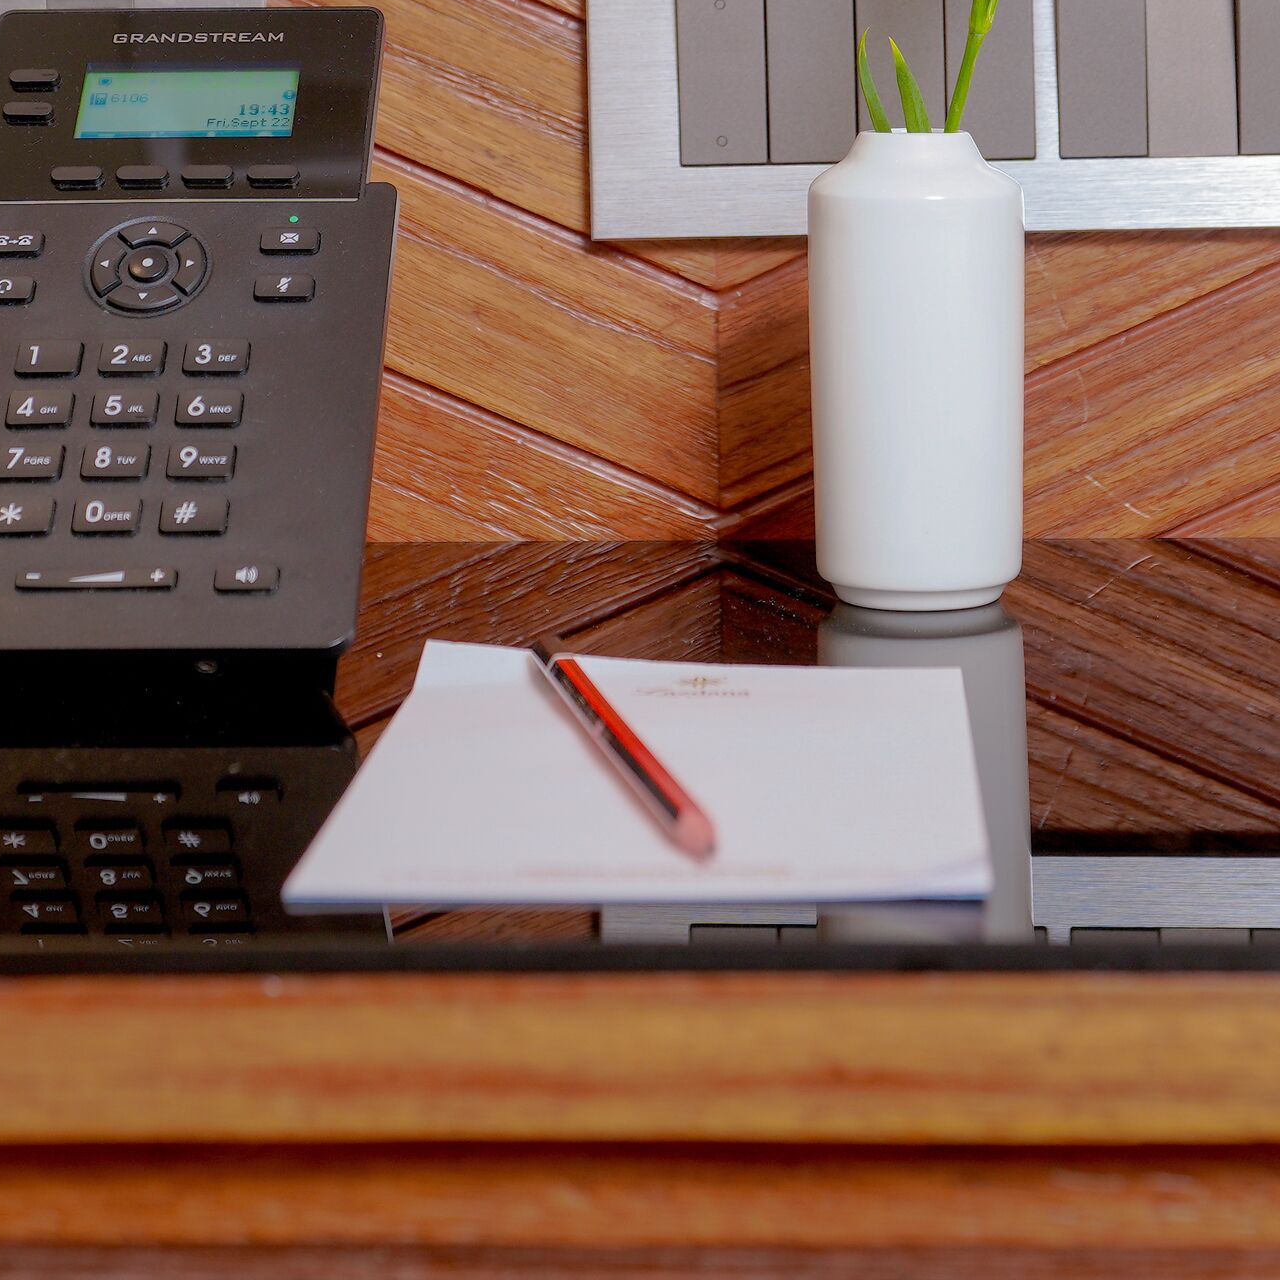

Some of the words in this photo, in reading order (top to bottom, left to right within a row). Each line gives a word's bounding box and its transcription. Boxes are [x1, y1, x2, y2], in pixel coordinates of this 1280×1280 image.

[113, 32, 284, 44] GRANDSTREAM
[239, 103, 290, 116] 19:43
[272, 117, 290, 127] 22
[29, 345, 40, 365] 1
[110, 345, 129, 364] 2
[131, 354, 152, 362] ABC
[195, 344, 212, 364] 3
[217, 354, 237, 362] DEF
[16, 397, 34, 417] 4
[39, 406, 57, 414] GHI
[104, 395, 122, 416] 5
[127, 405, 144, 413] JKL
[187, 395, 205, 417] 6
[209, 406, 232, 414] MNO
[7, 447, 24, 469] 7
[23, 457, 50, 465] PQRS
[94, 446, 112, 468] 8
[116, 456, 136, 465] TUV
[179, 446, 198, 468] 9
[199, 456, 227, 465] WXYZ
[85, 501, 103, 523] 0
[103, 512, 131, 521] OPER
